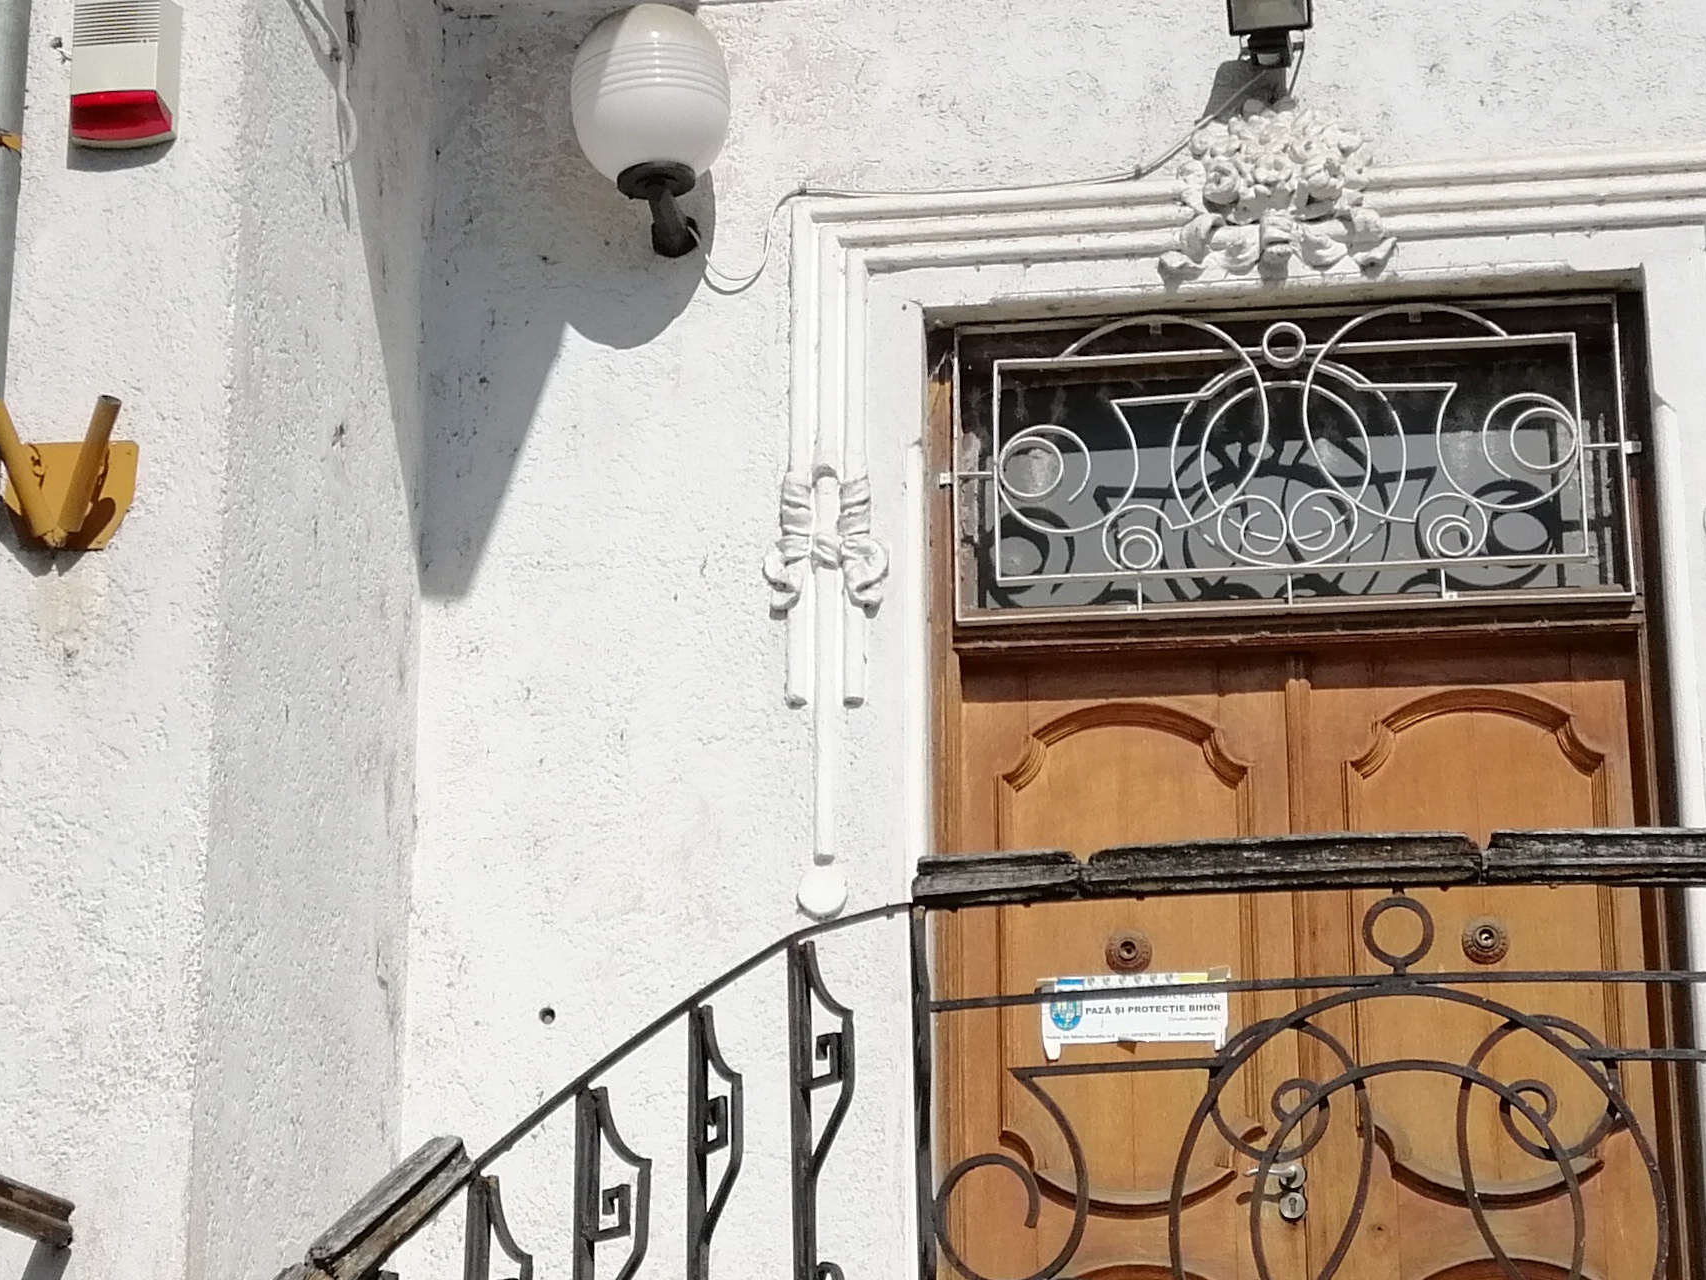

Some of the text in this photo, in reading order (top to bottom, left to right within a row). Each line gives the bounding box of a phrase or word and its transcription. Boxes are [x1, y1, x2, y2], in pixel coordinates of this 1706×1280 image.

[1085, 1005, 1112, 1015] PAZĂ
[1128, 1004, 1185, 1014] PROTECȚIE
[1188, 1003, 1221, 1012] BIHOR
